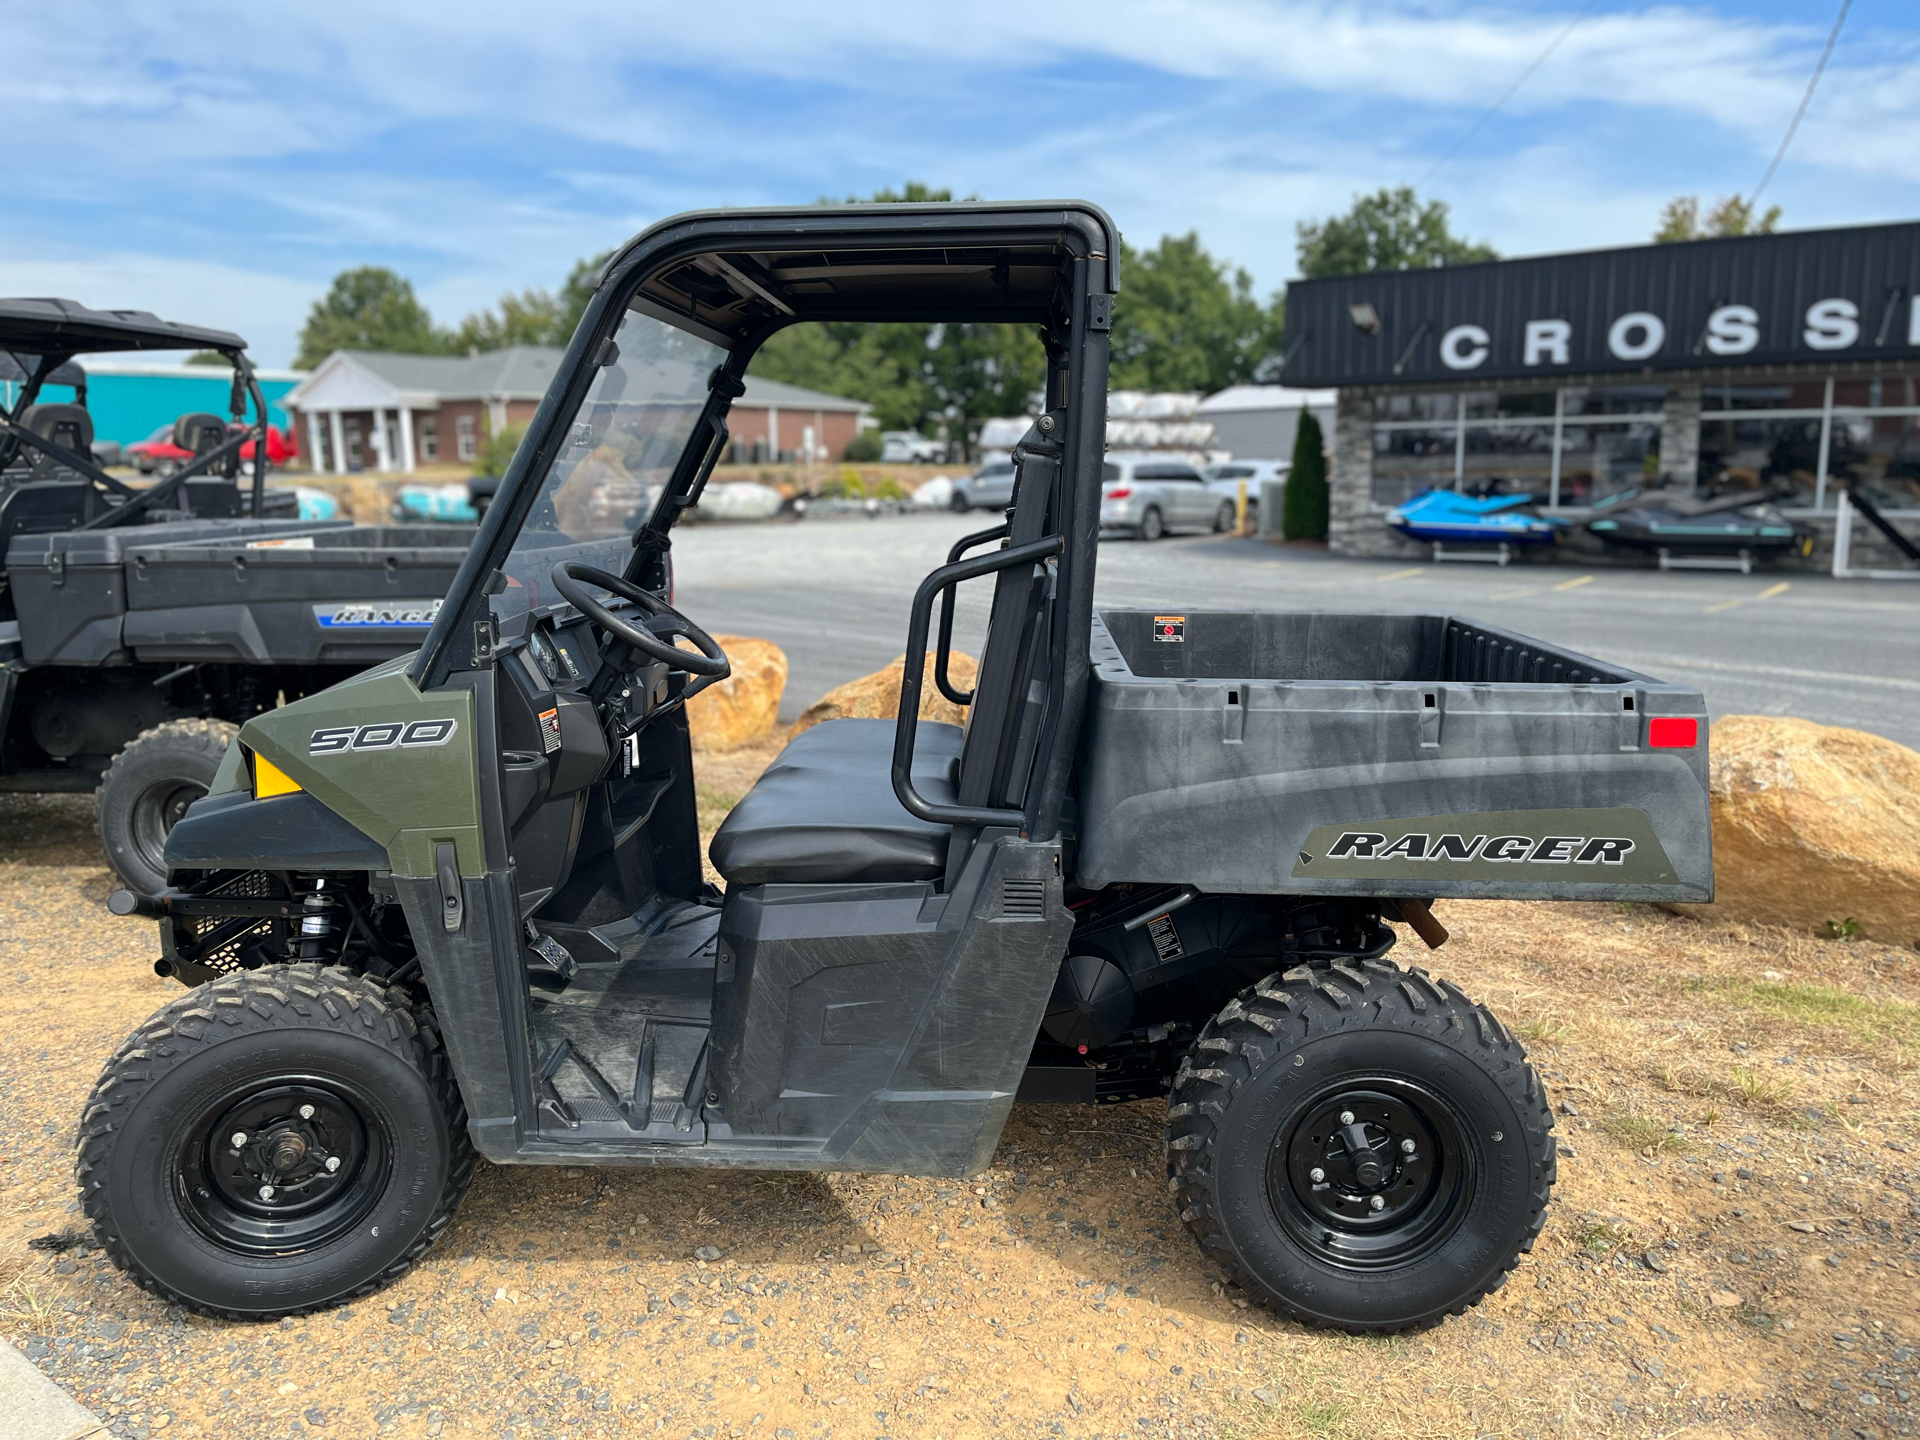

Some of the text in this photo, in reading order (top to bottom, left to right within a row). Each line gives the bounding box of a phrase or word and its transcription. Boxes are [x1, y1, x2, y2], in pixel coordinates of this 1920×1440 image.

[1440, 295, 1920, 370] CROSS
[331, 610, 438, 624] RANGE
[309, 718, 458, 756] 500
[1326, 831, 1635, 866] RANGER
